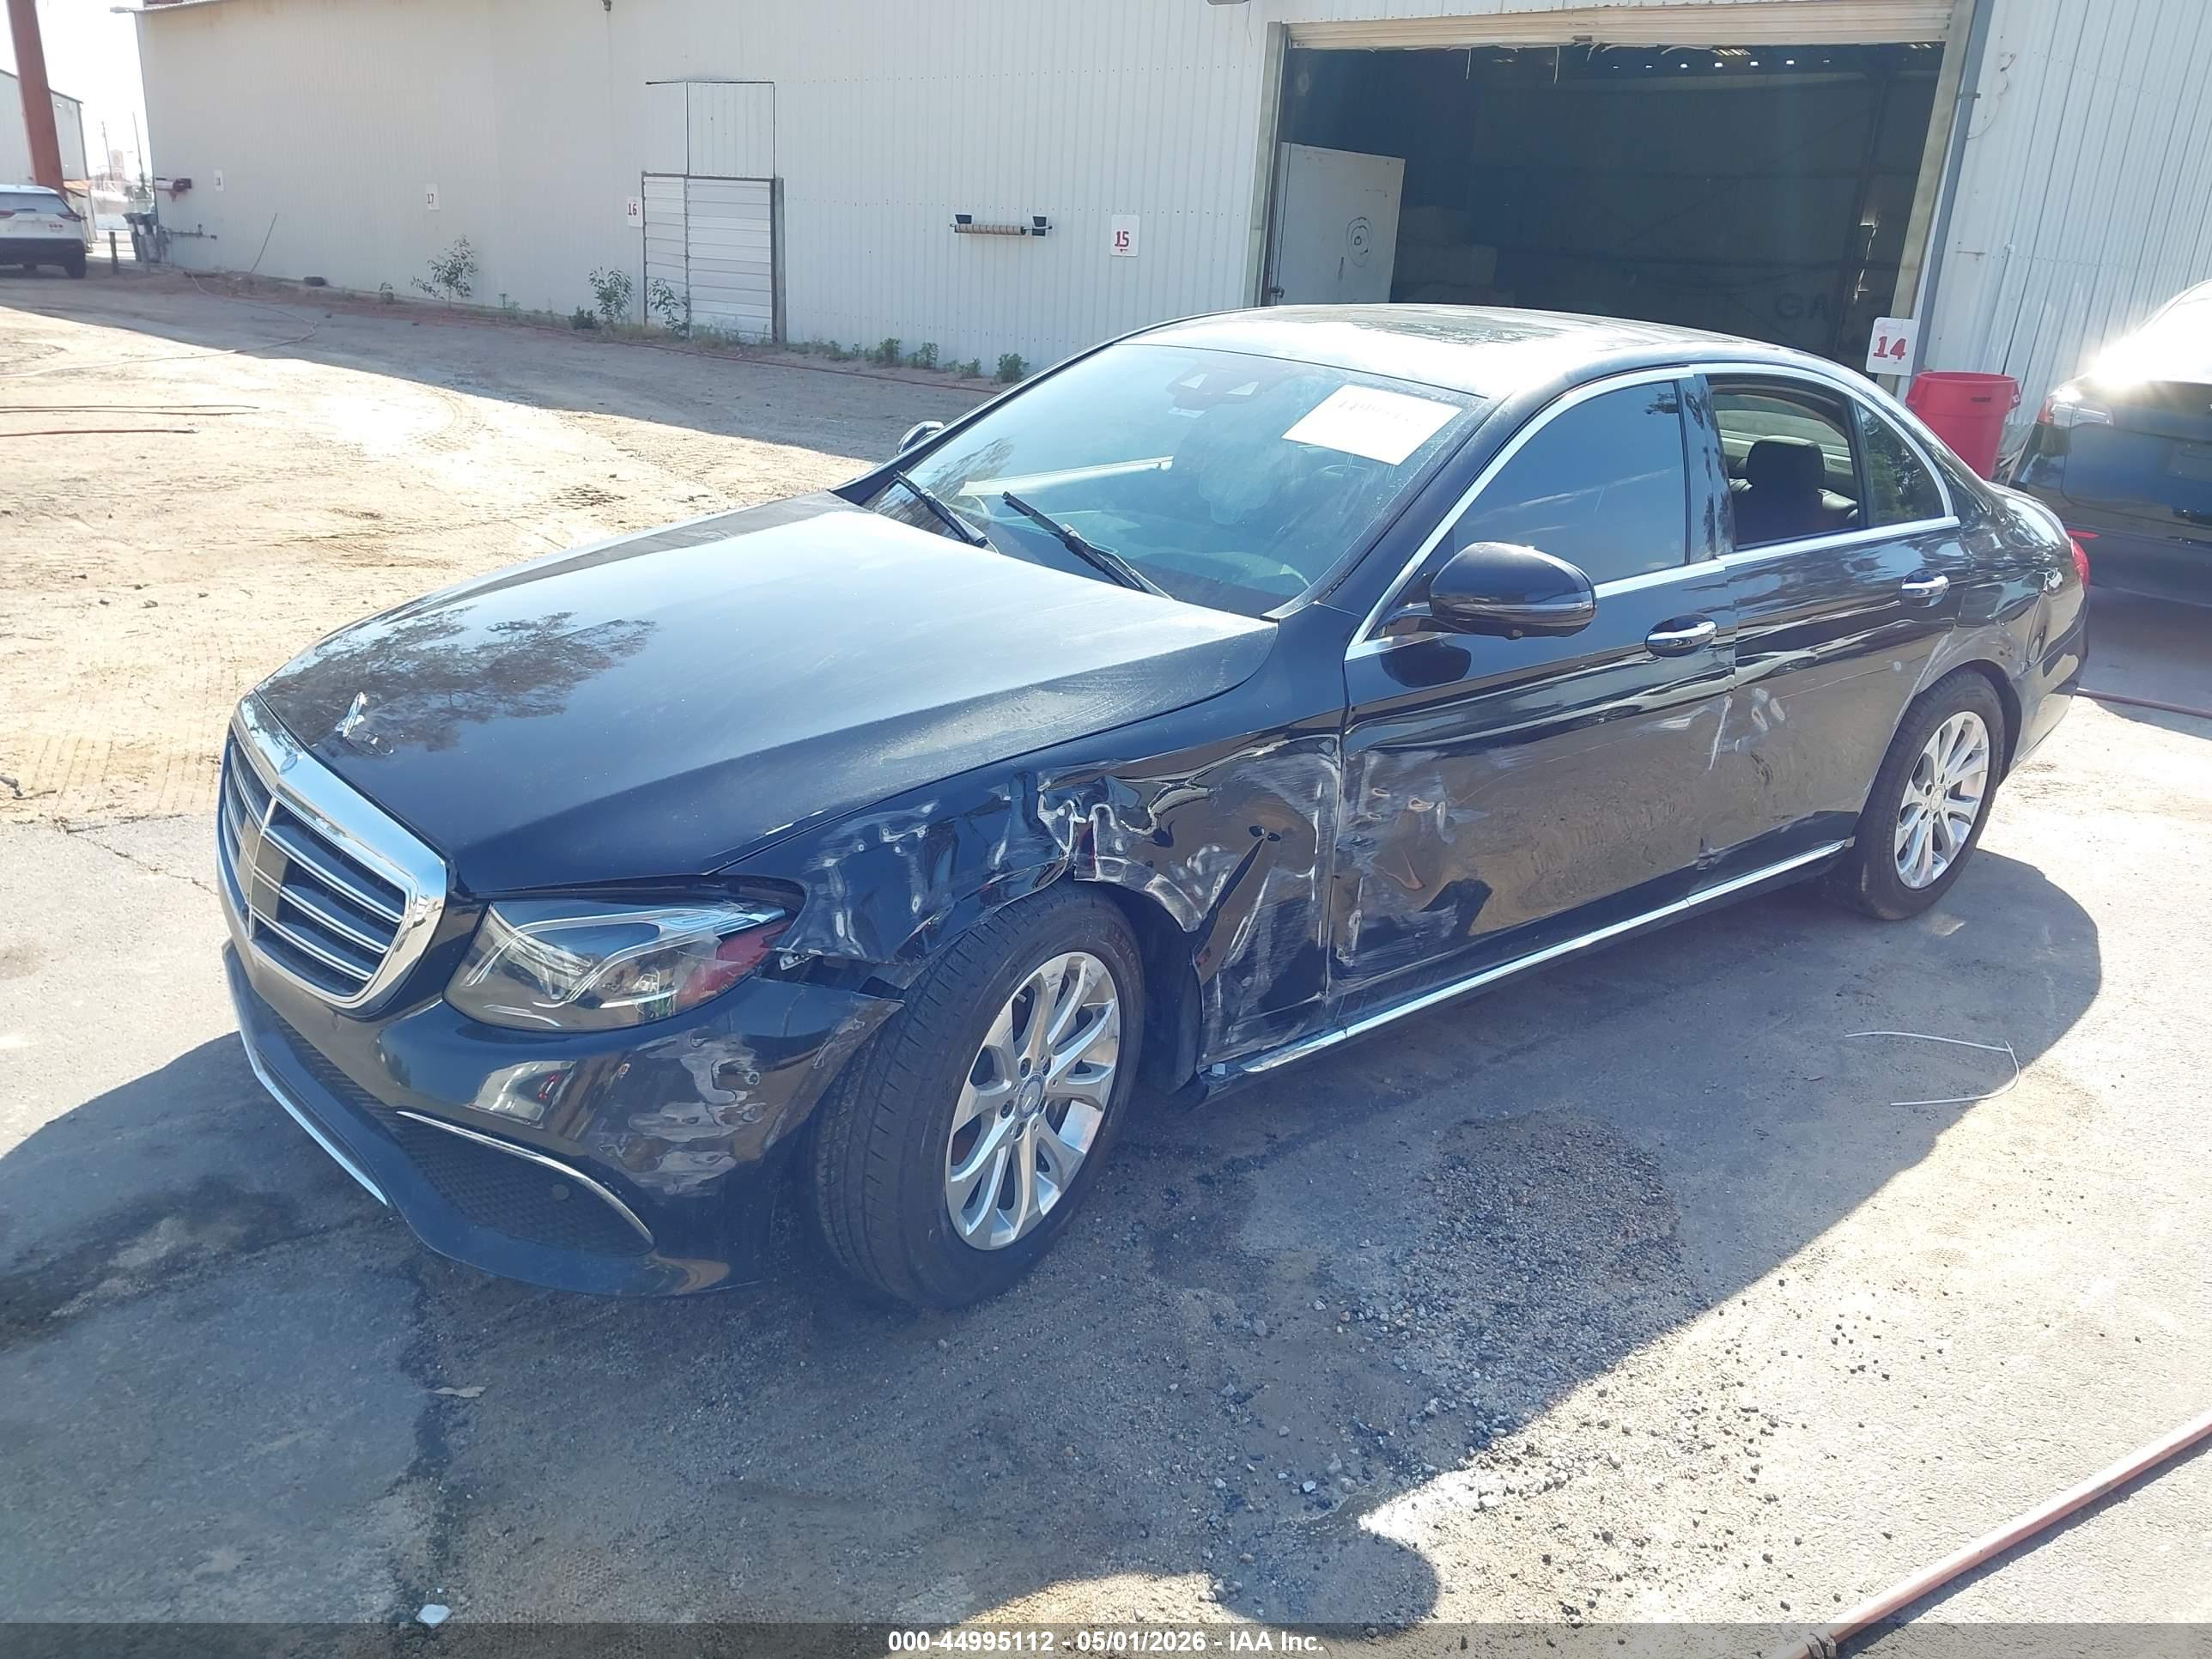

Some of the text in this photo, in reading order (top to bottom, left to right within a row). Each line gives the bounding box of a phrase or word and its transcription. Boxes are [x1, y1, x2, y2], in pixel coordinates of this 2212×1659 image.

[427, 192, 434, 204] 17
[628, 203, 637, 216] 16
[1115, 231, 1129, 247] 15
[1873, 336, 1906, 360] 14
